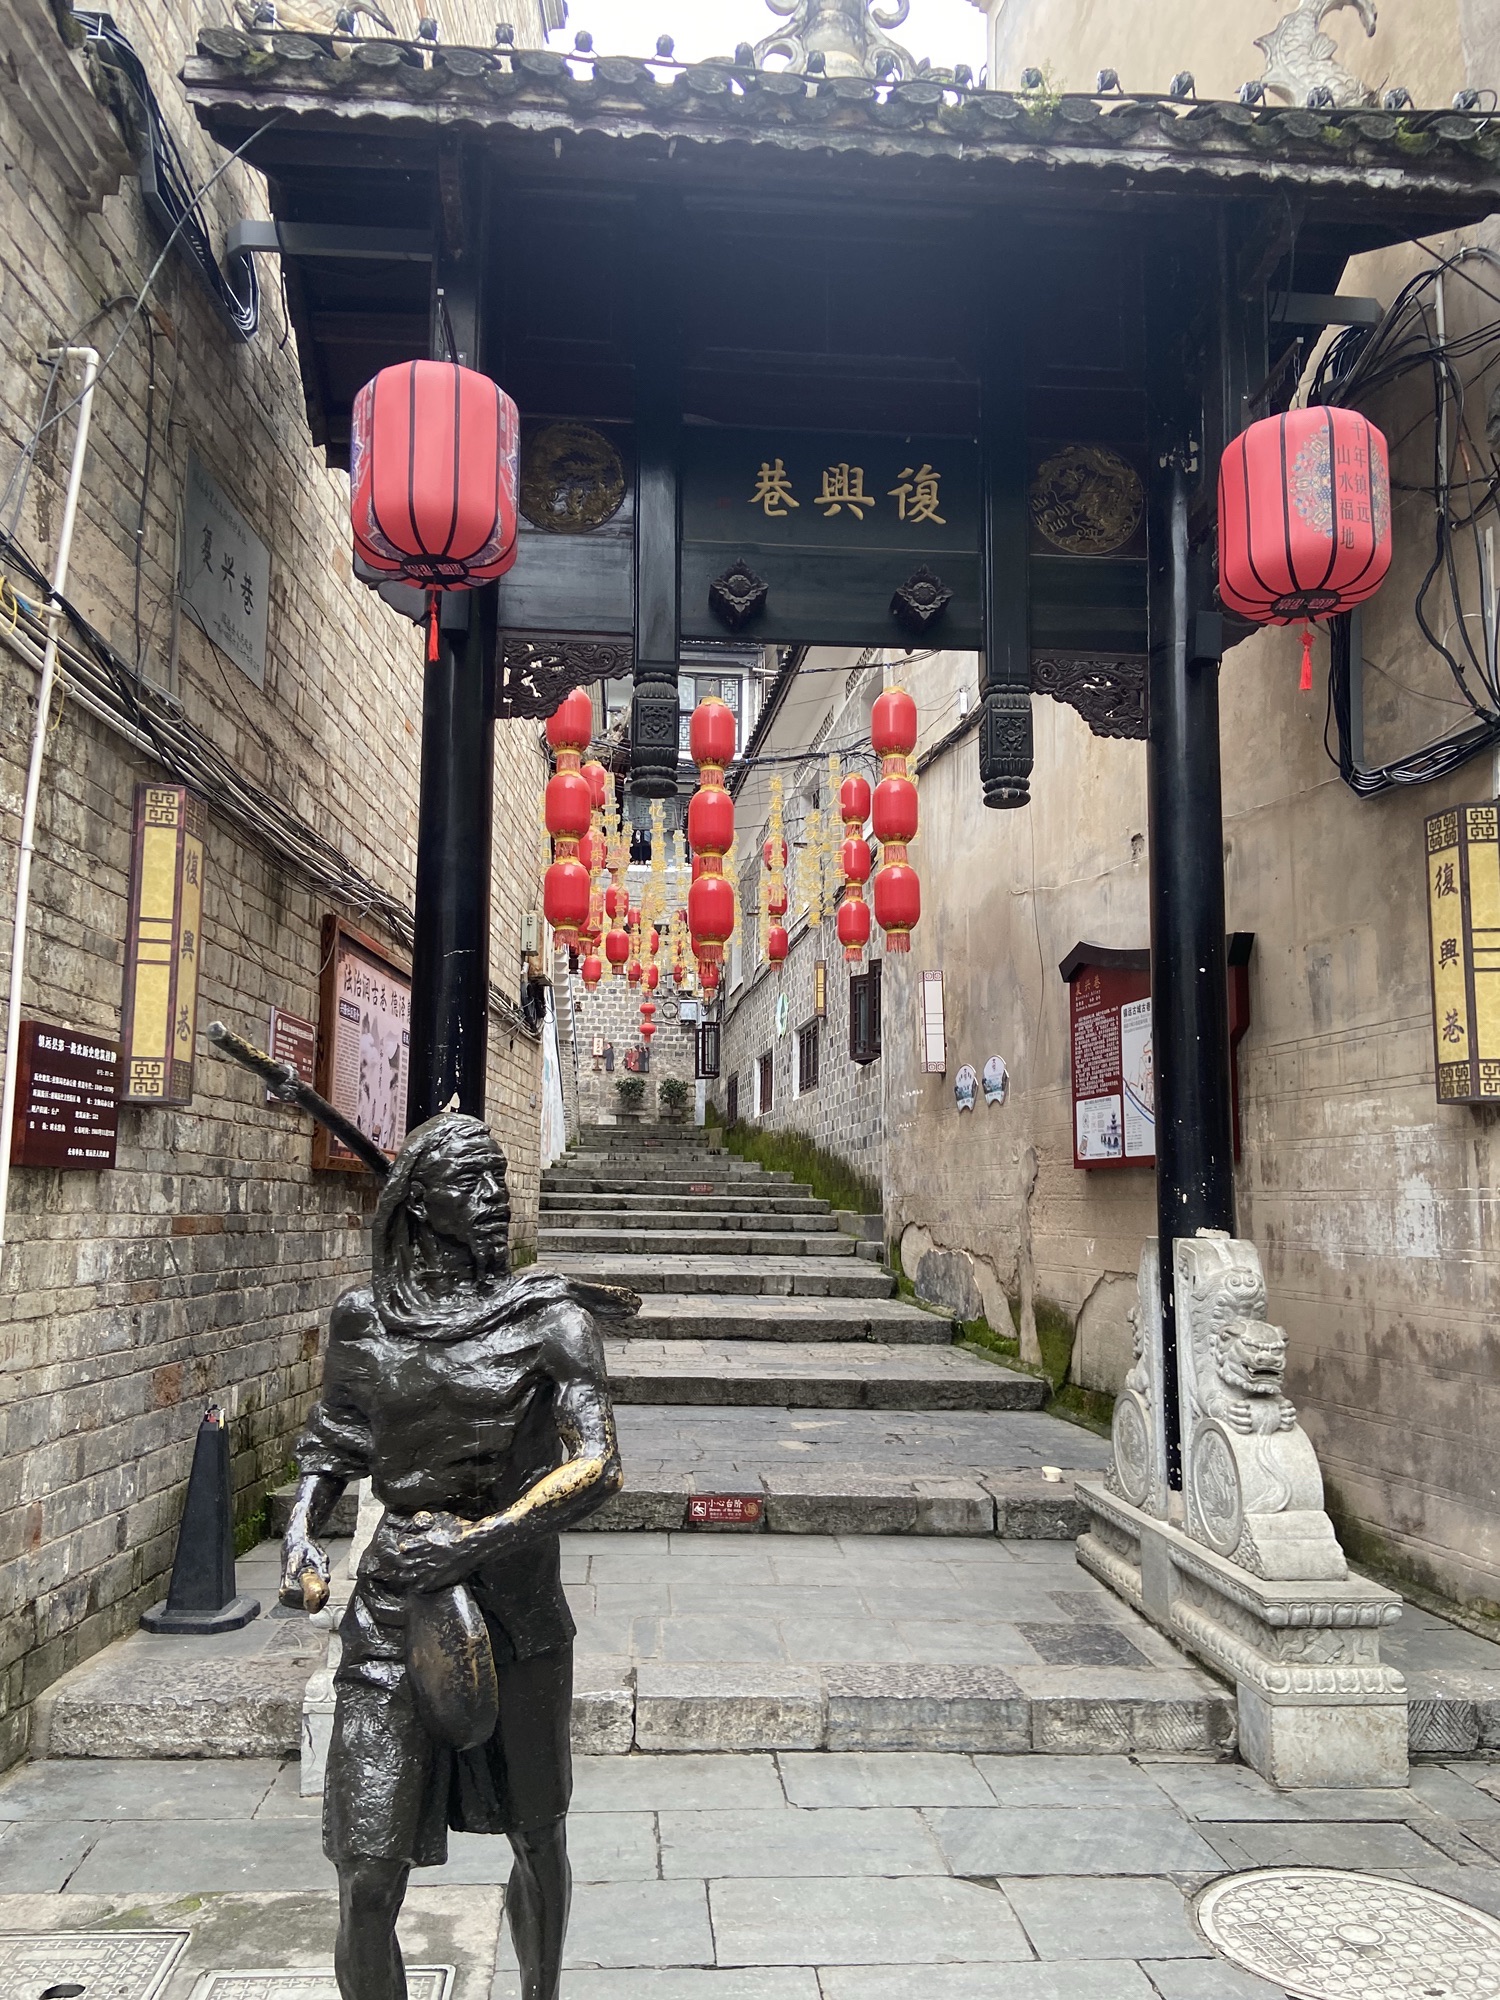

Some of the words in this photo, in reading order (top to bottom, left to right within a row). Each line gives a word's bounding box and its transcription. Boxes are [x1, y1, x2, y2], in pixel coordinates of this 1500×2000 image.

[1337, 445, 1355, 549] 山水福地
[1352, 421, 1370, 524] 千年镇远
[201, 523, 254, 616] 复兴巷
[827, 757, 848, 879] 自信人生二百年
[176, 850, 200, 1042] 復興巷
[1075, 975, 1102, 996] 复兴巷
[1434, 863, 1465, 1043] 復興巷
[708, 1499, 743, 1508] 小心台阶
